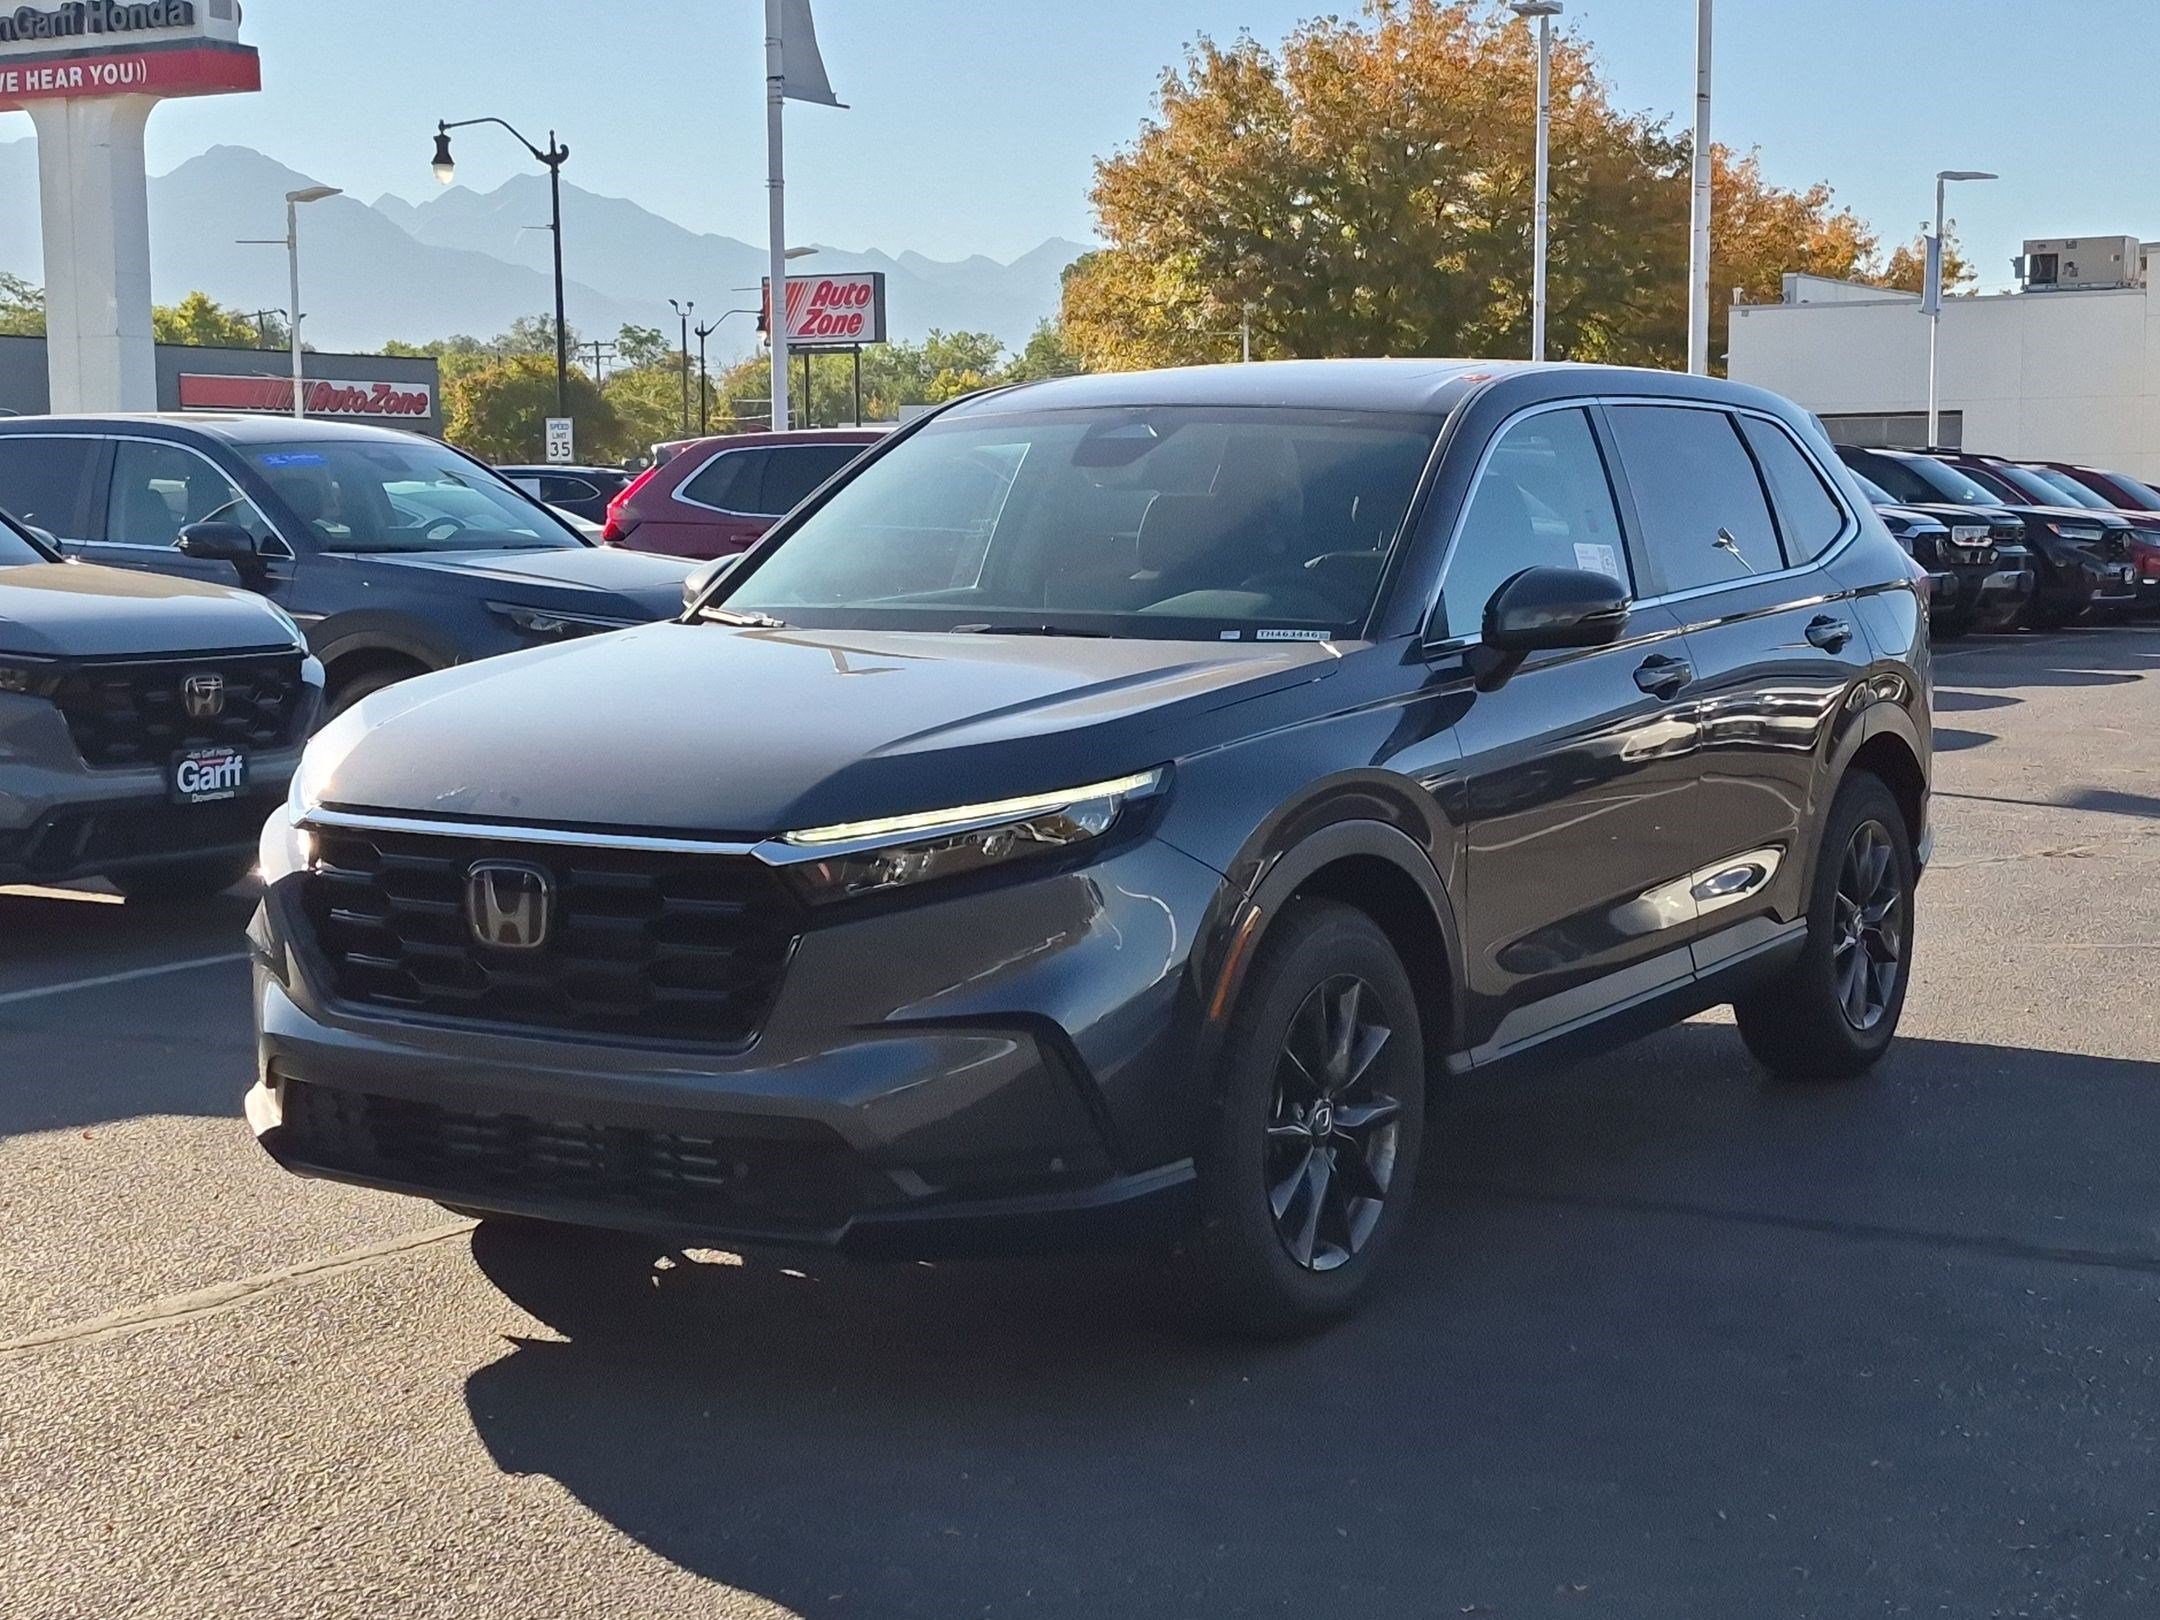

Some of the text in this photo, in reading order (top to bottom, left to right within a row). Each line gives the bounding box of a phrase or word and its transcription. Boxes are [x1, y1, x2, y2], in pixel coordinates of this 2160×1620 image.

[86, 0, 193, 34] Honda
[26, 66, 83, 91] HEAR
[810, 280, 871, 308] Auto
[797, 308, 863, 336] Zone
[308, 381, 428, 415] AutoZone
[550, 423, 570, 431] SPEED
[550, 442, 570, 457] 35
[177, 755, 242, 793] Garff
